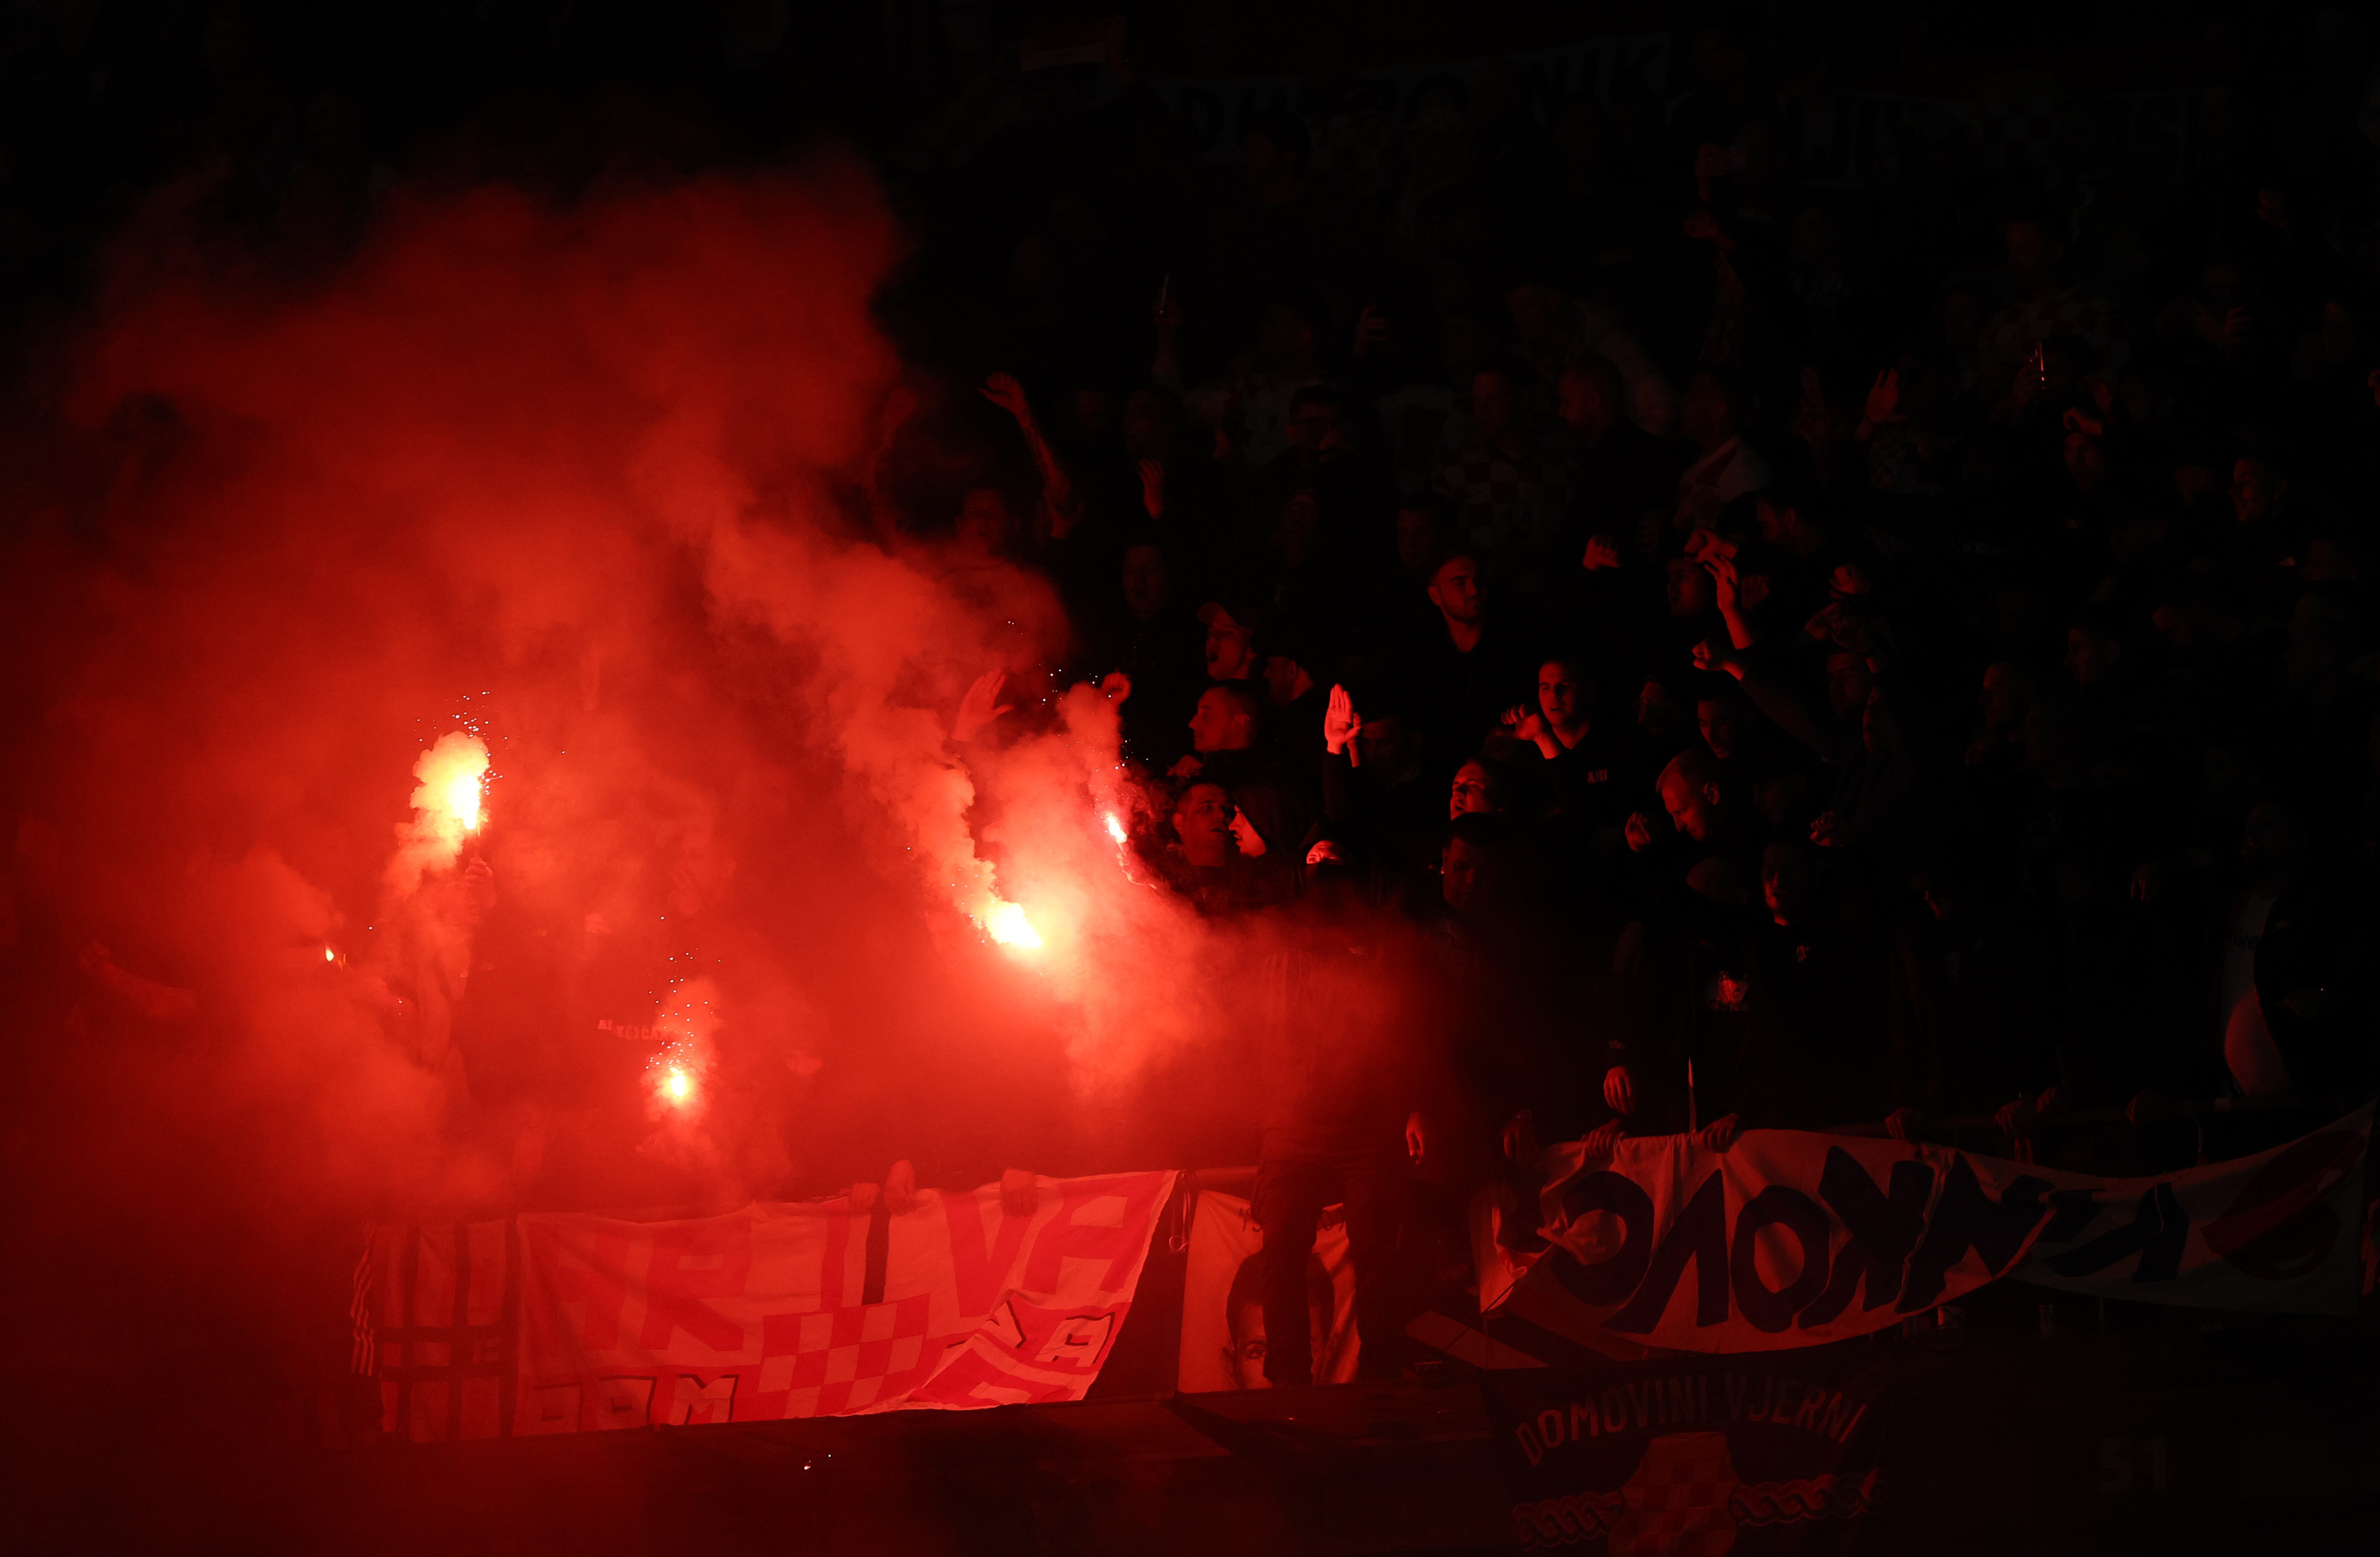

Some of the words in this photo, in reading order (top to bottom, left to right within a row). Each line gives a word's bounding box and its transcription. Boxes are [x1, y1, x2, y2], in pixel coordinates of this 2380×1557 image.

[1514, 1373, 1707, 1468] DOMOVINI
[1724, 1373, 1870, 1444] VJERNI
[2097, 1435, 2167, 1495] 51
